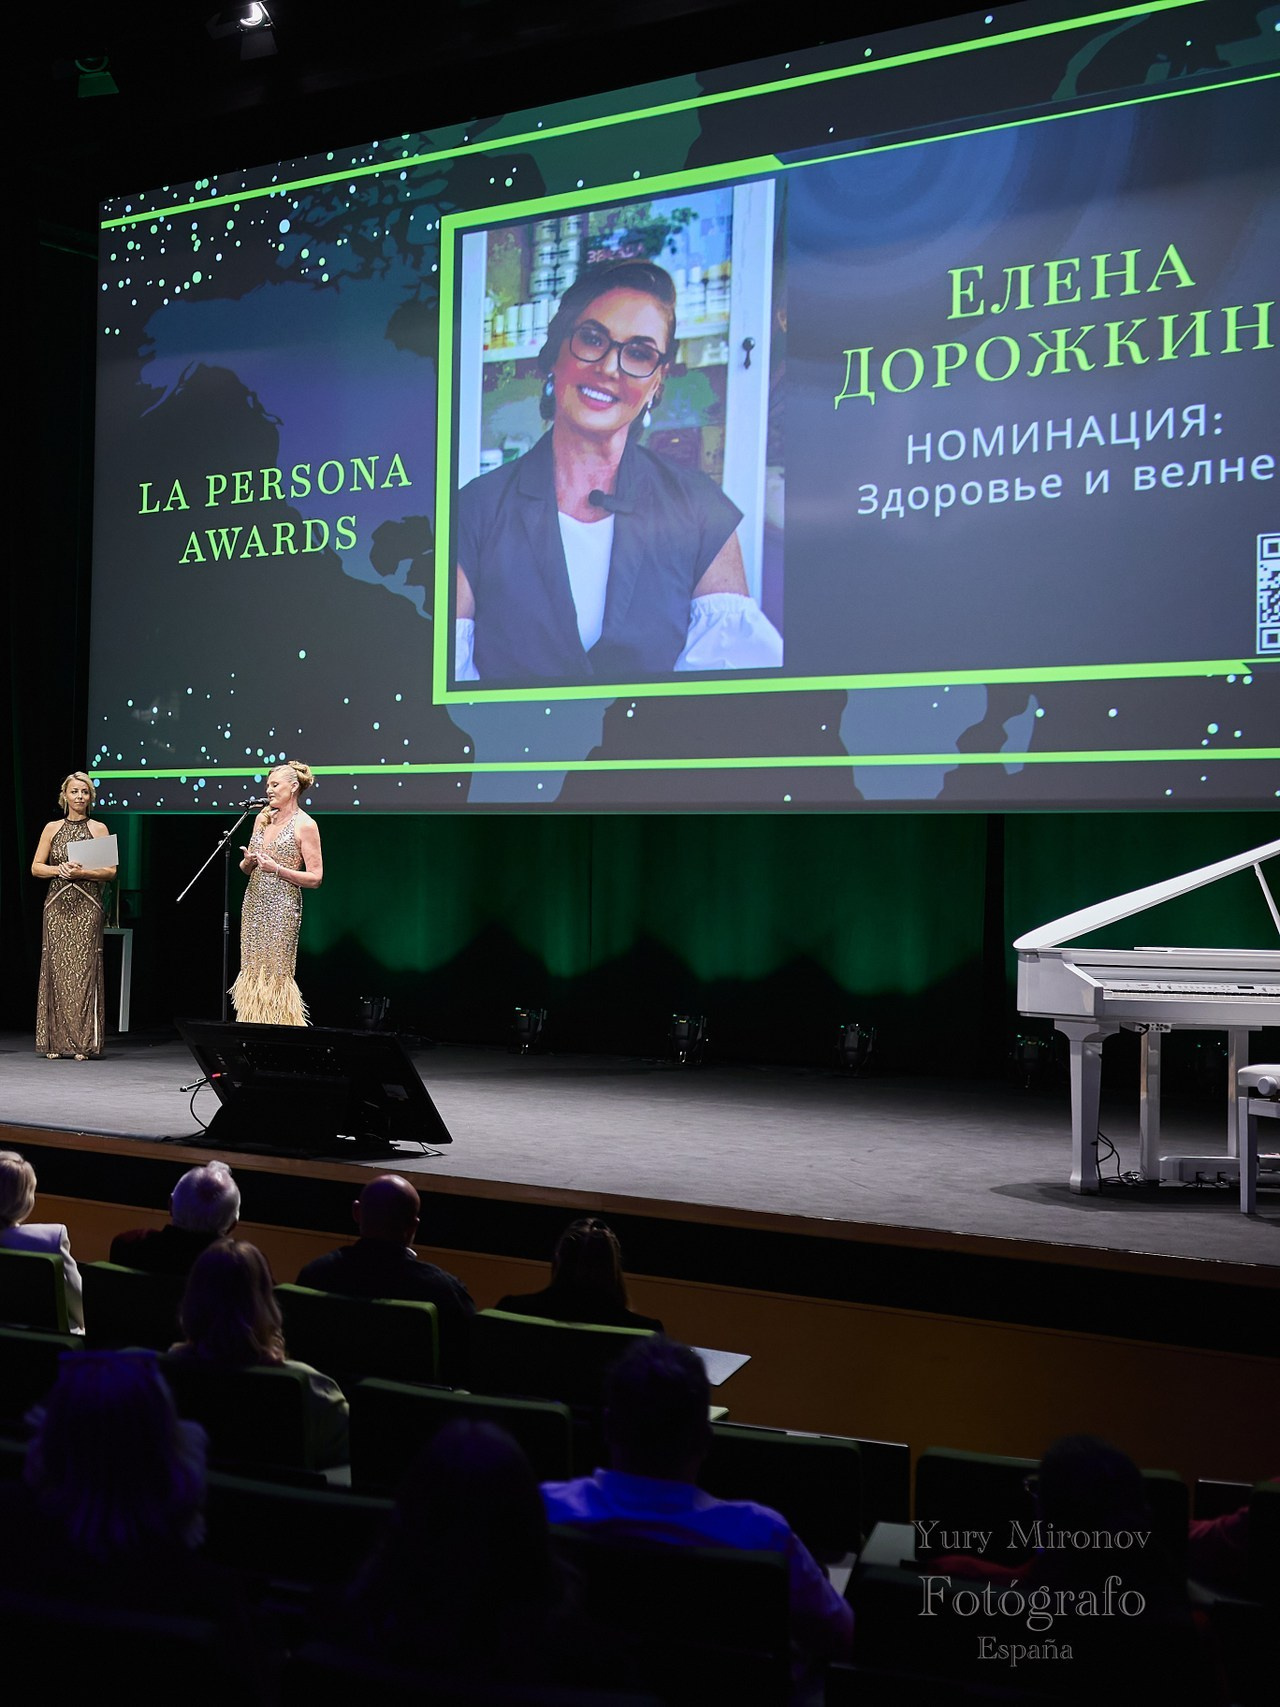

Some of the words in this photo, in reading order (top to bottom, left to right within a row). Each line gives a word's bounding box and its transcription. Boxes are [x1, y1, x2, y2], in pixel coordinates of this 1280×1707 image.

[947, 243, 1196, 320] ЕЛЕНА
[833, 301, 1276, 410] ДОРОЖКИН
[906, 404, 1224, 465] НОМИНАЦИЯ:
[138, 478, 190, 515] LA
[204, 452, 412, 507] PERSONA
[856, 472, 1063, 519] Здоровье
[1085, 468, 1110, 495] и
[1132, 452, 1276, 492] велне
[178, 515, 358, 564] AWARDS
